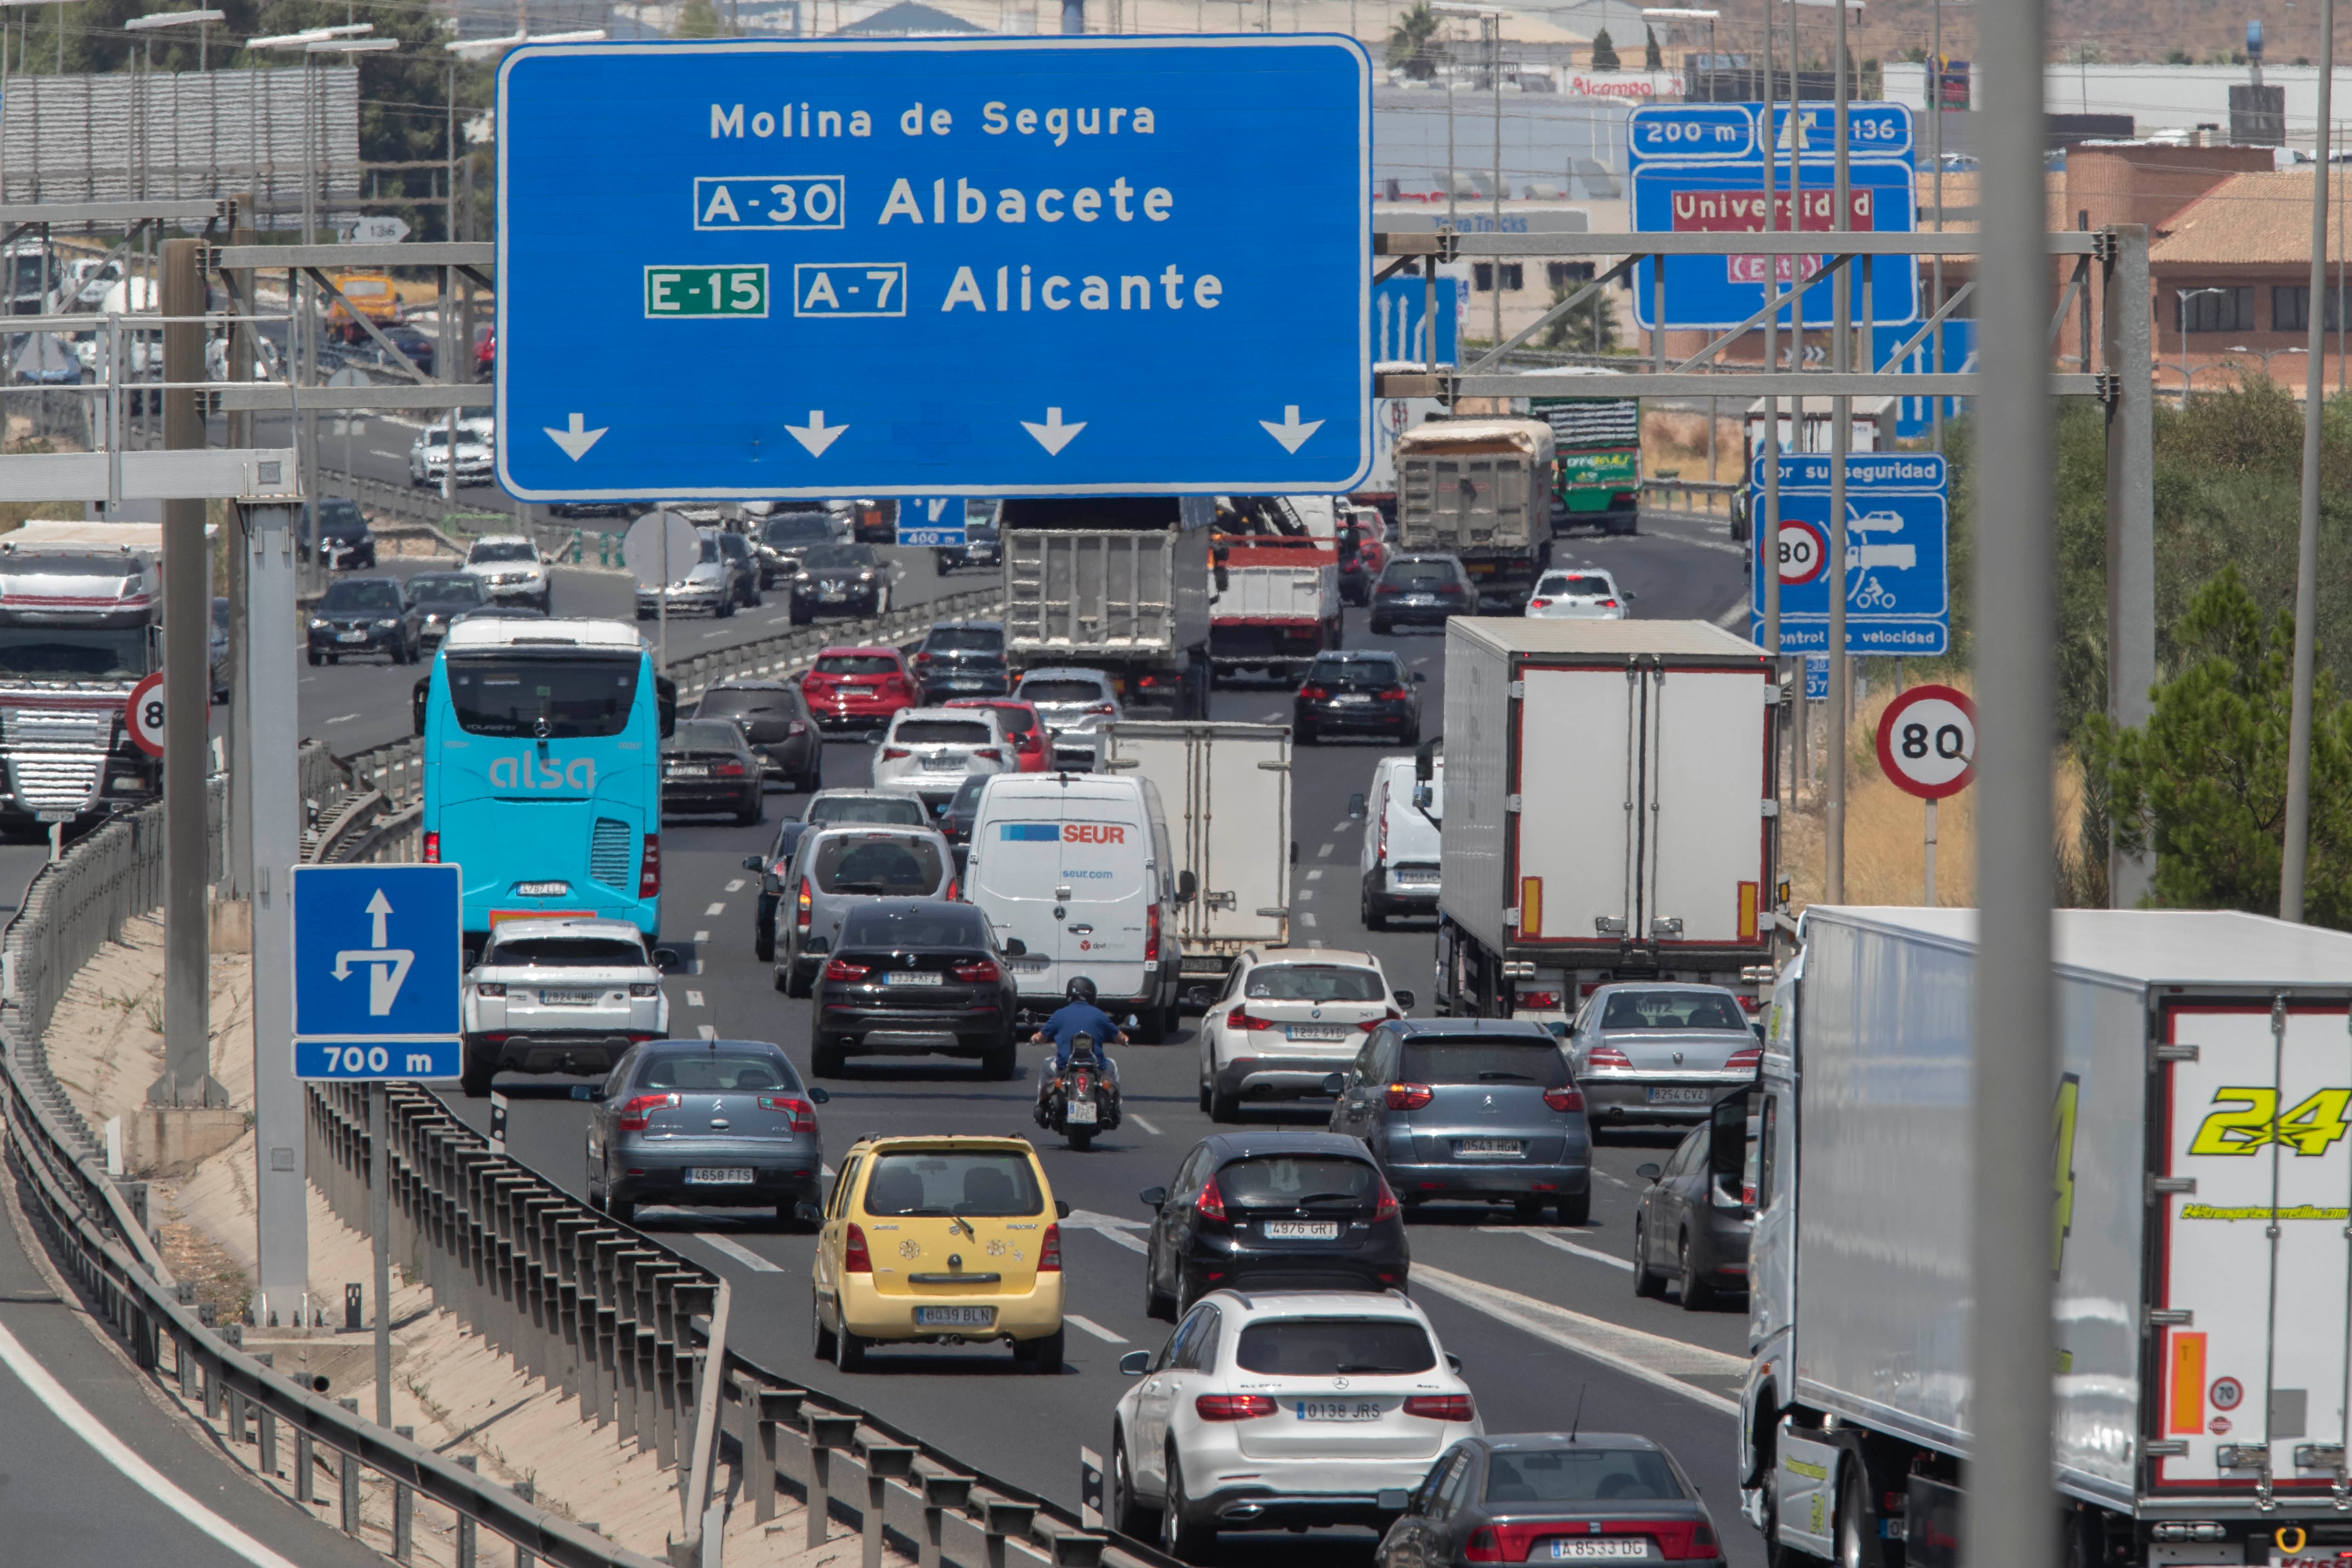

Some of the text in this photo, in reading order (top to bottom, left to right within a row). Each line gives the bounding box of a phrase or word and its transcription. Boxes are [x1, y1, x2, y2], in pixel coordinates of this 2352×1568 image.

[711, 101, 1155, 147] Molina de Segura
[1646, 121, 1736, 143] 200 m
[1853, 119, 1896, 140] 136
[702, 176, 1173, 225] A-30 Albacete
[1676, 193, 1870, 219] Universidd
[652, 263, 1223, 312] E-15 A-7 Alicante
[1762, 463, 1793, 478] or
[1805, 467, 1829, 479] su
[907, 532, 956, 544] 400 m
[1779, 542, 1811, 564] 80
[1777, 631, 1826, 645] ontrol
[1862, 630, 1935, 644] velocidad
[1901, 723, 1964, 760] 80
[489, 750, 596, 792] alsa
[1063, 824, 1125, 844] SEUR
[1062, 869, 1113, 879] seur.com
[323, 1047, 432, 1072] 700 m
[1654, 1089, 1705, 1100] 8254 CVZ
[2186, 1085, 2352, 1156] 24
[1464, 1140, 1492, 1151] 0543
[694, 1169, 751, 1181] 4658 FTS
[1272, 1222, 1305, 1234] 4976
[1311, 1222, 1335, 1234] GRT
[926, 1308, 990, 1321] 8039 BLN
[2218, 1386, 2235, 1401] 70
[1308, 1403, 1381, 1419] 0138 JRS
[1562, 1540, 1643, 1556] A 8533 DG
